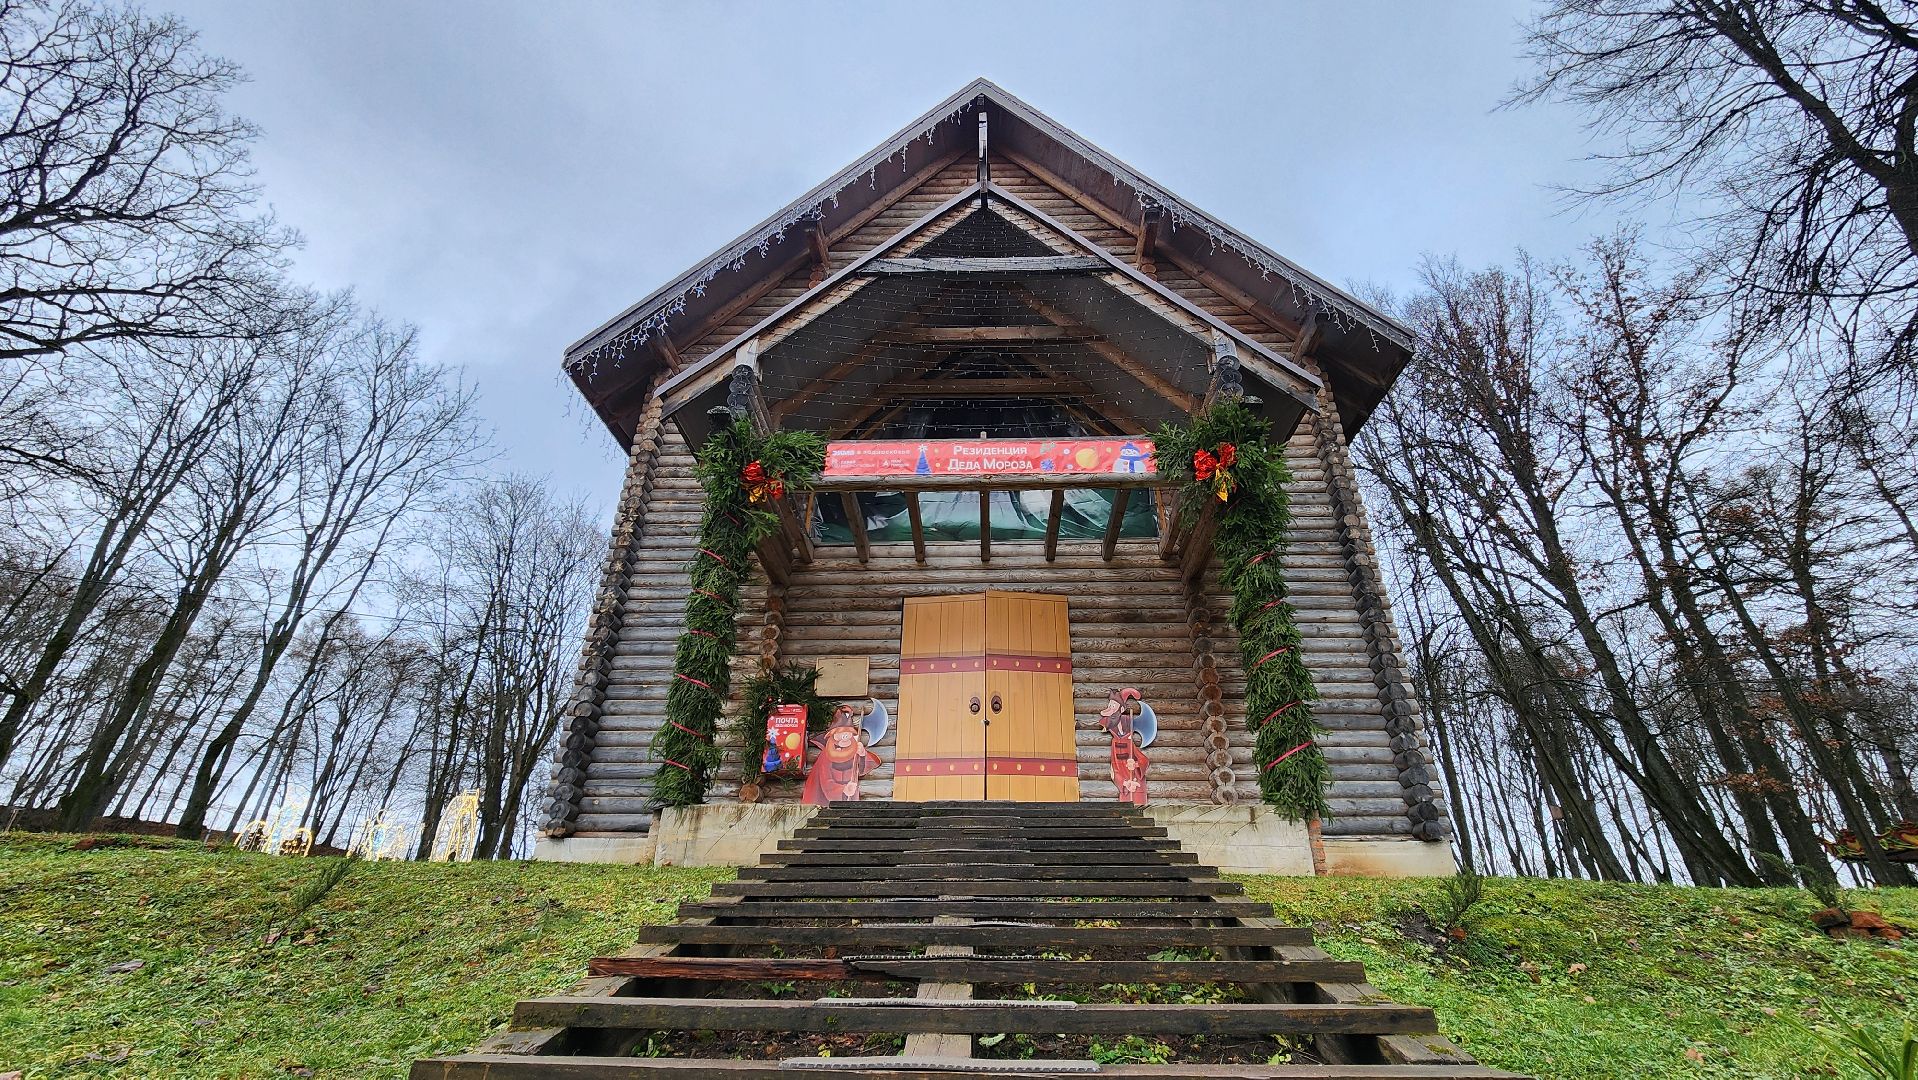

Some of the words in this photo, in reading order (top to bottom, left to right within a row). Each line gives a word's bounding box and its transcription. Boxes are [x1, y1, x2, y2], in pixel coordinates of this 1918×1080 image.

[953, 445, 1028, 456] РЕЗИДЕНЦИЯ
[947, 458, 981, 471] ДЕДА
[983, 458, 1034, 470] МОРОЗА
